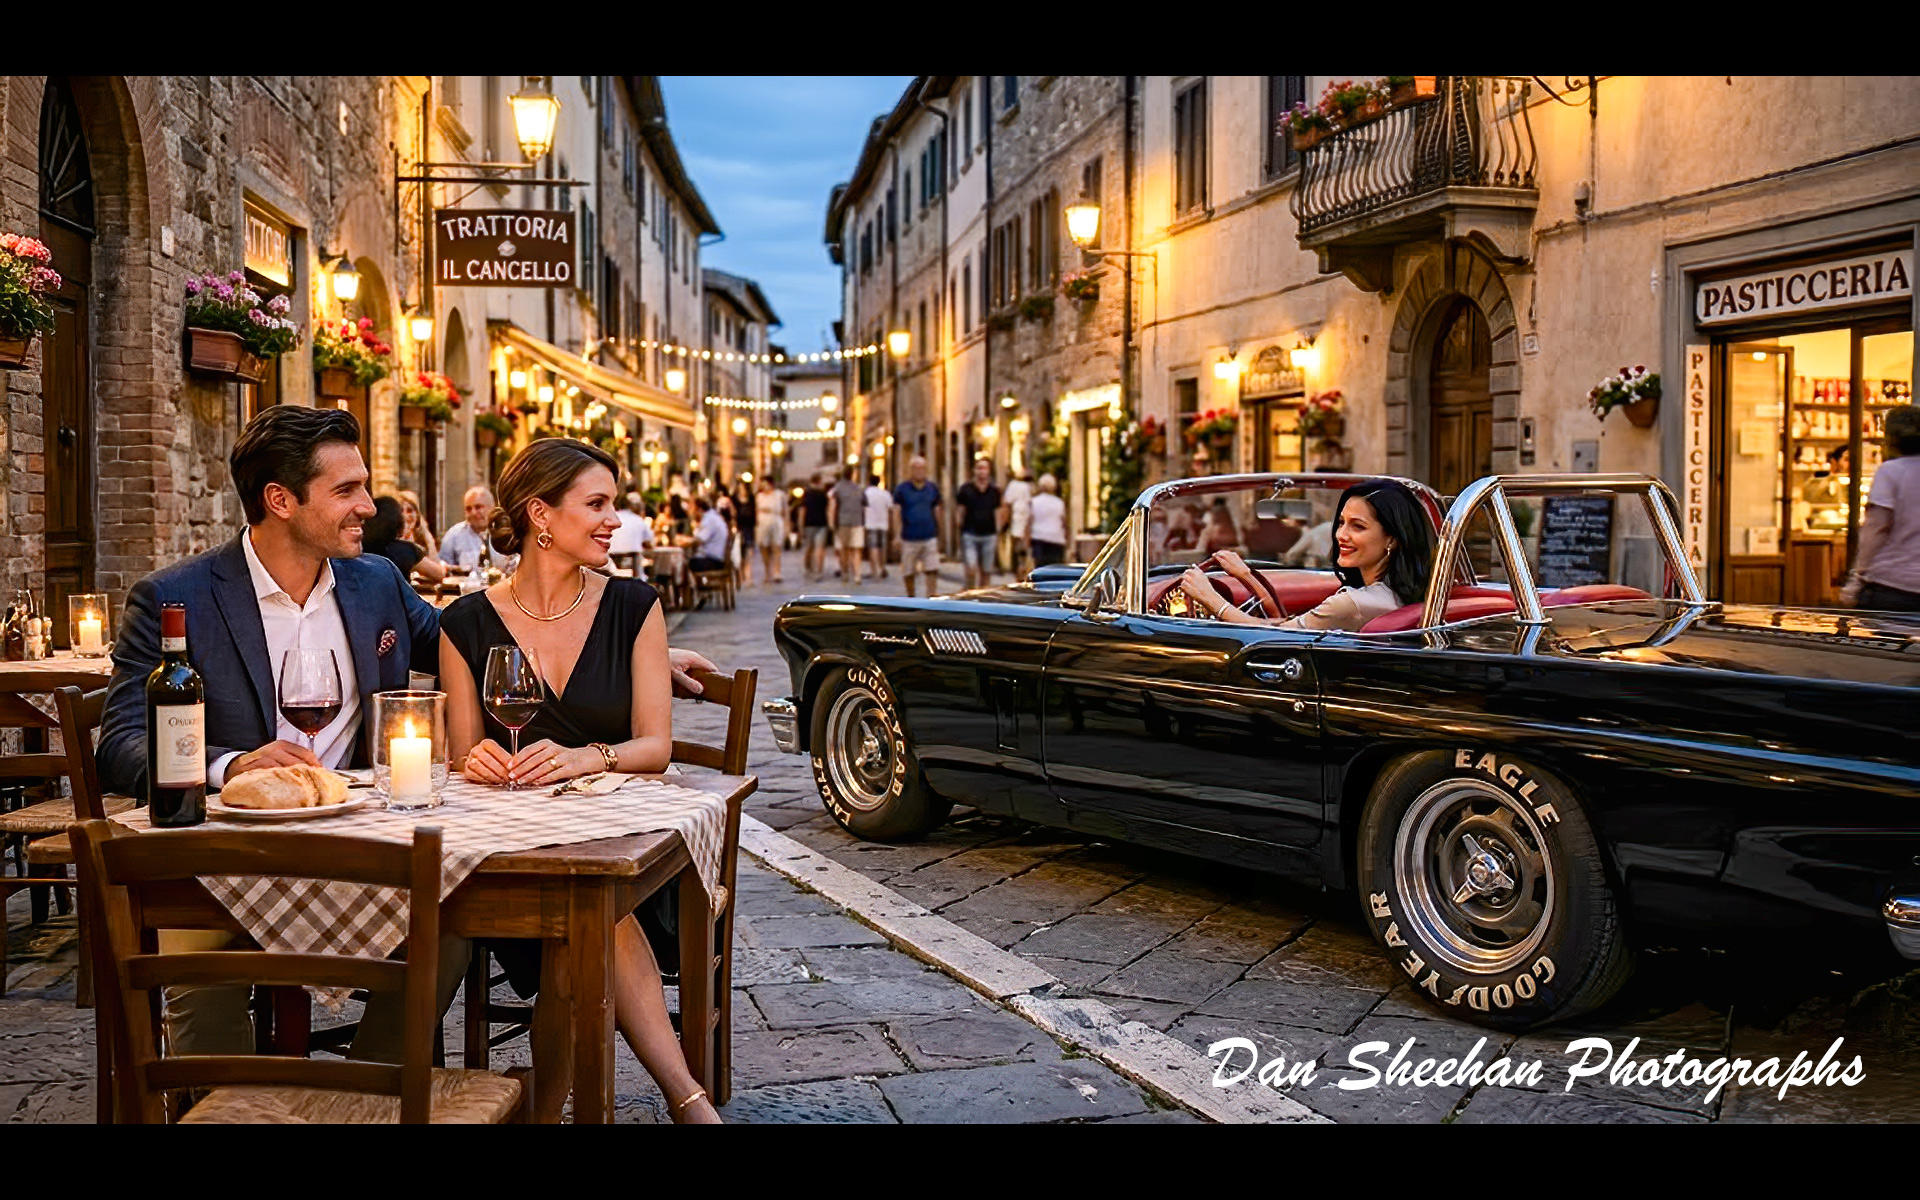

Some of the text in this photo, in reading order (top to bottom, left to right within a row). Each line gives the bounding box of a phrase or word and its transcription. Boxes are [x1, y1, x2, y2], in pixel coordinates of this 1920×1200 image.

[441, 215, 569, 245] TRATTORIA
[443, 259, 570, 282] IL CANCELLO
[1703, 257, 1910, 318] PASTICCERIA
[1690, 352, 1704, 562] PASTICCERIA
[1455, 748, 1560, 828] EAGLE
[1369, 888, 1556, 1012] GOODYEAR
